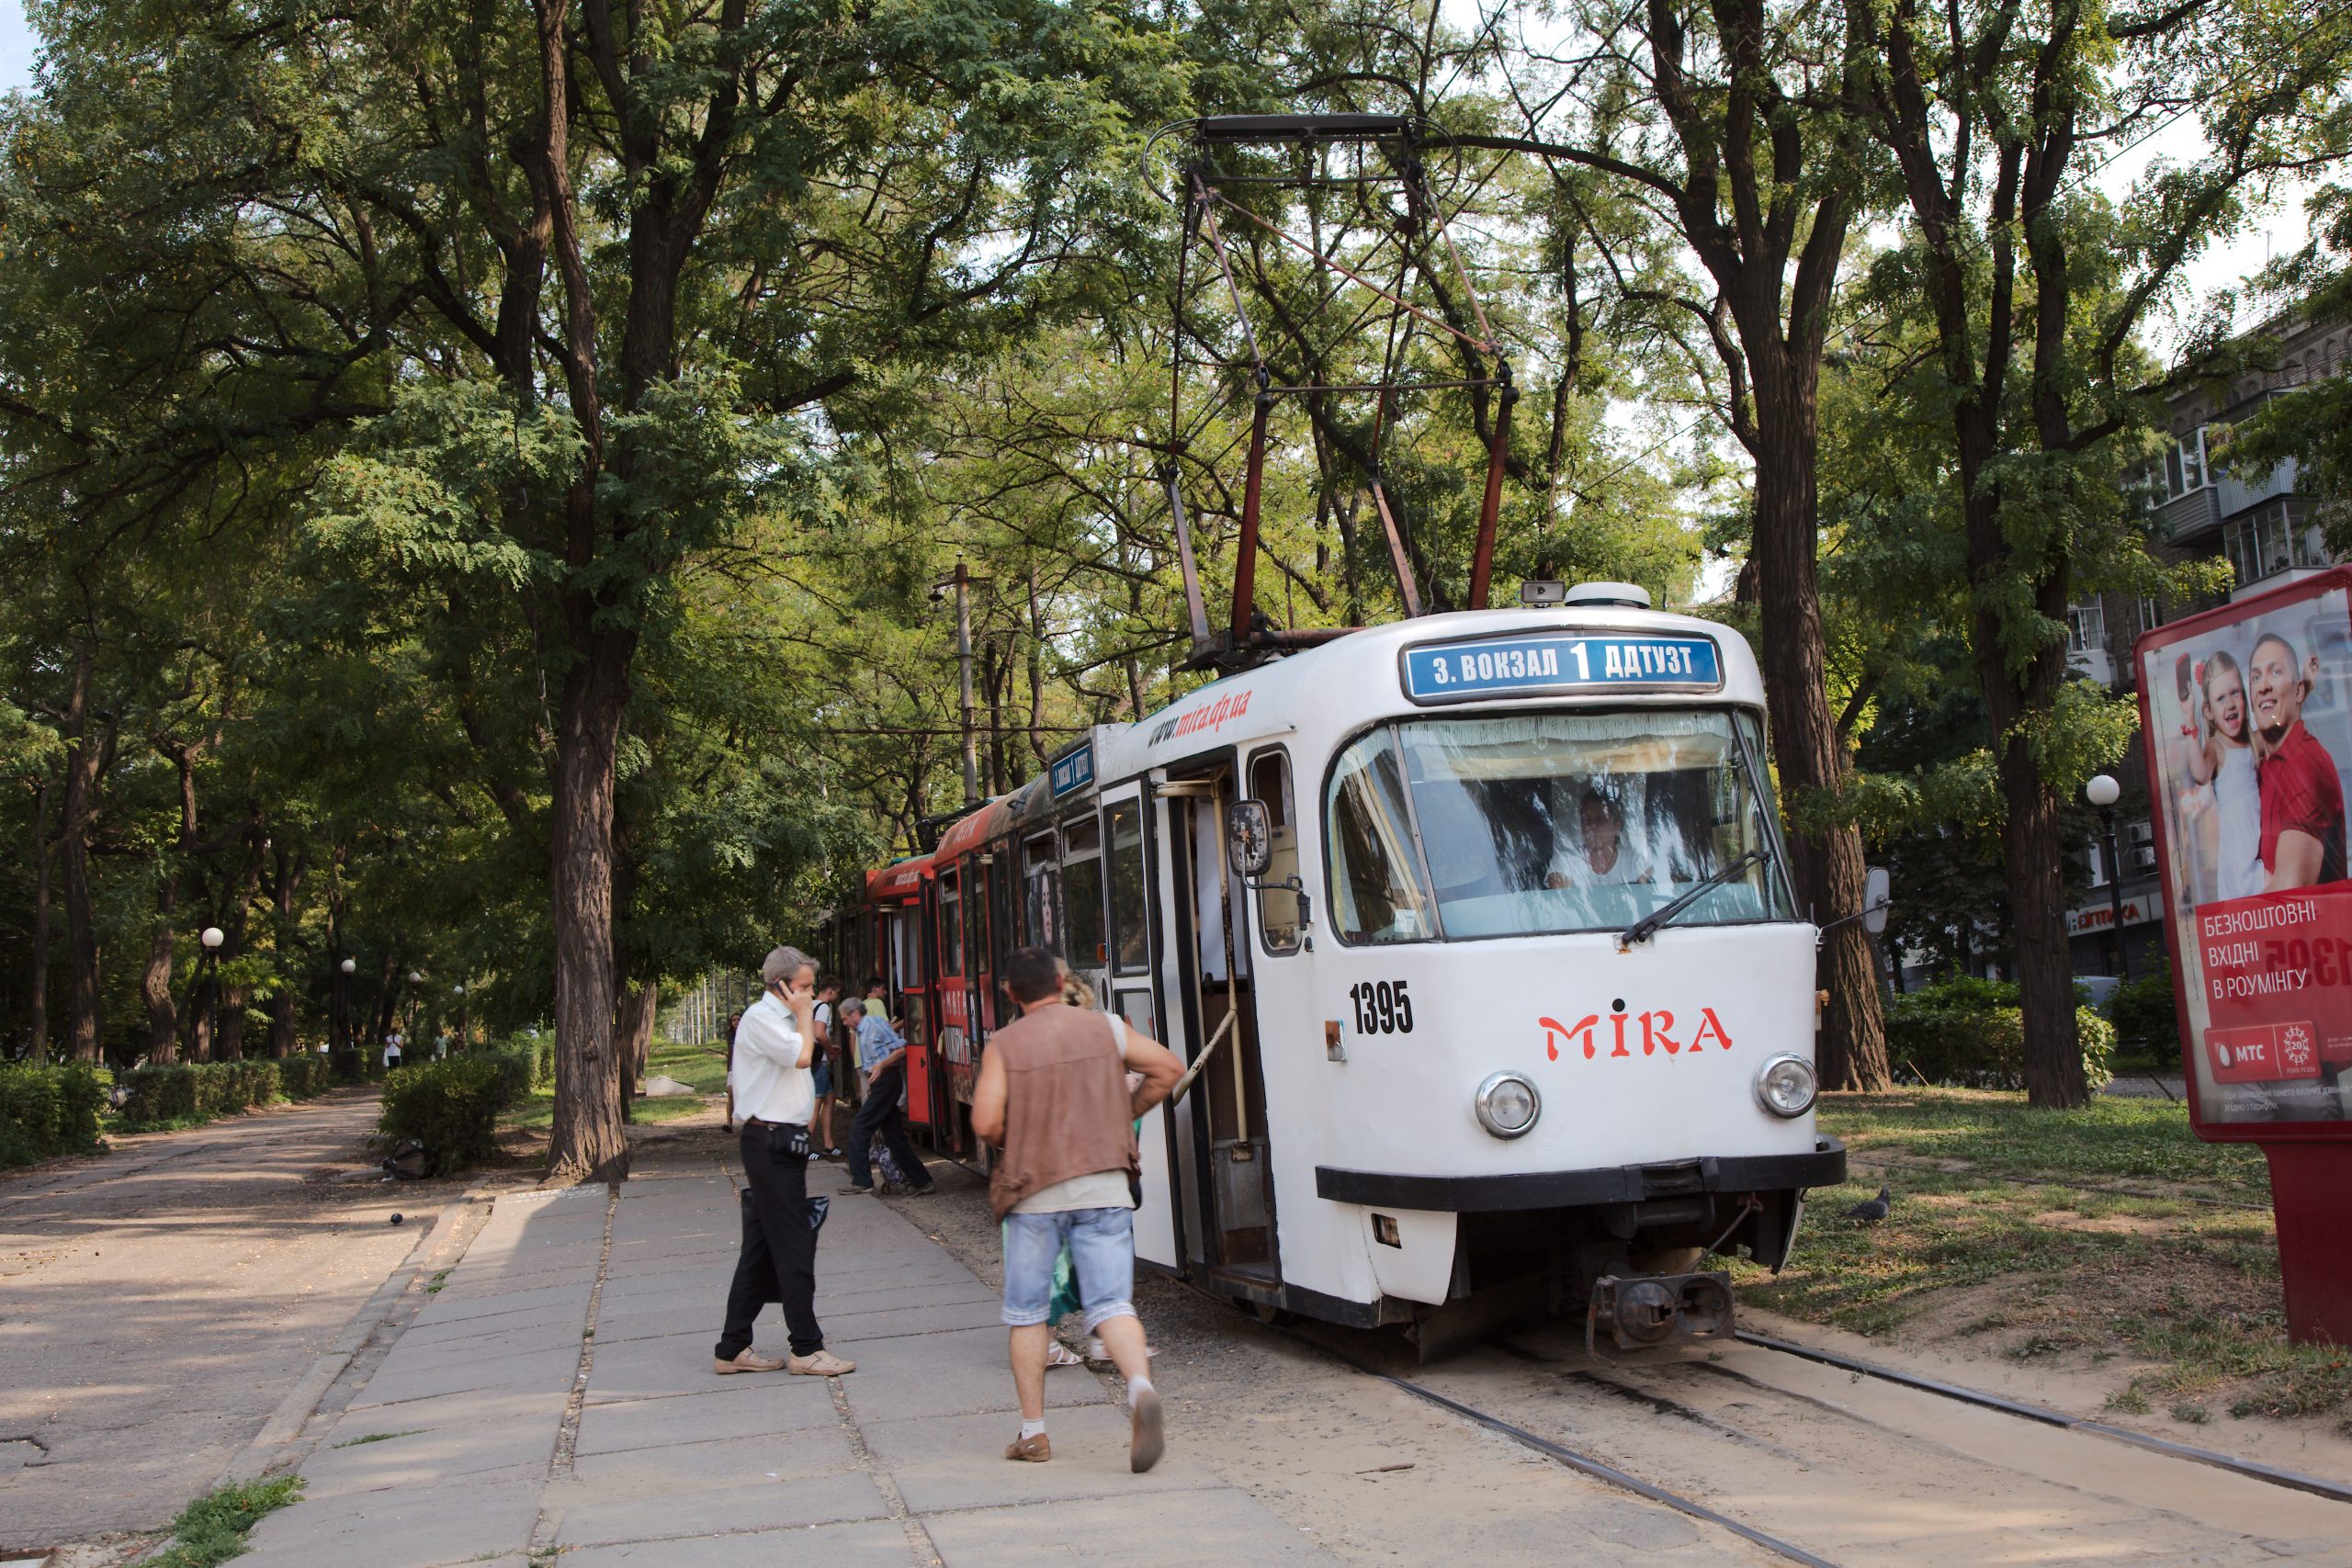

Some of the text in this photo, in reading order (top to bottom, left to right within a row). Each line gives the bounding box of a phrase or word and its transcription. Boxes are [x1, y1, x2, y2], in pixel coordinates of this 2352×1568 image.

[1432, 641, 1692, 684] З. ВОКЗАЛ 1 ДДТУЗТ
[1148, 690, 1253, 749] www.mira.dp.ua
[2205, 899, 2317, 937] БЕЗКОШТОВНІ
[2208, 941, 2259, 968] ВХІДНІ
[2212, 967, 2308, 999] В РОУМІНГУ
[1349, 980, 1414, 1034] 1395
[2235, 1043, 2265, 1062] МТС
[2290, 1041, 2303, 1051] 20
